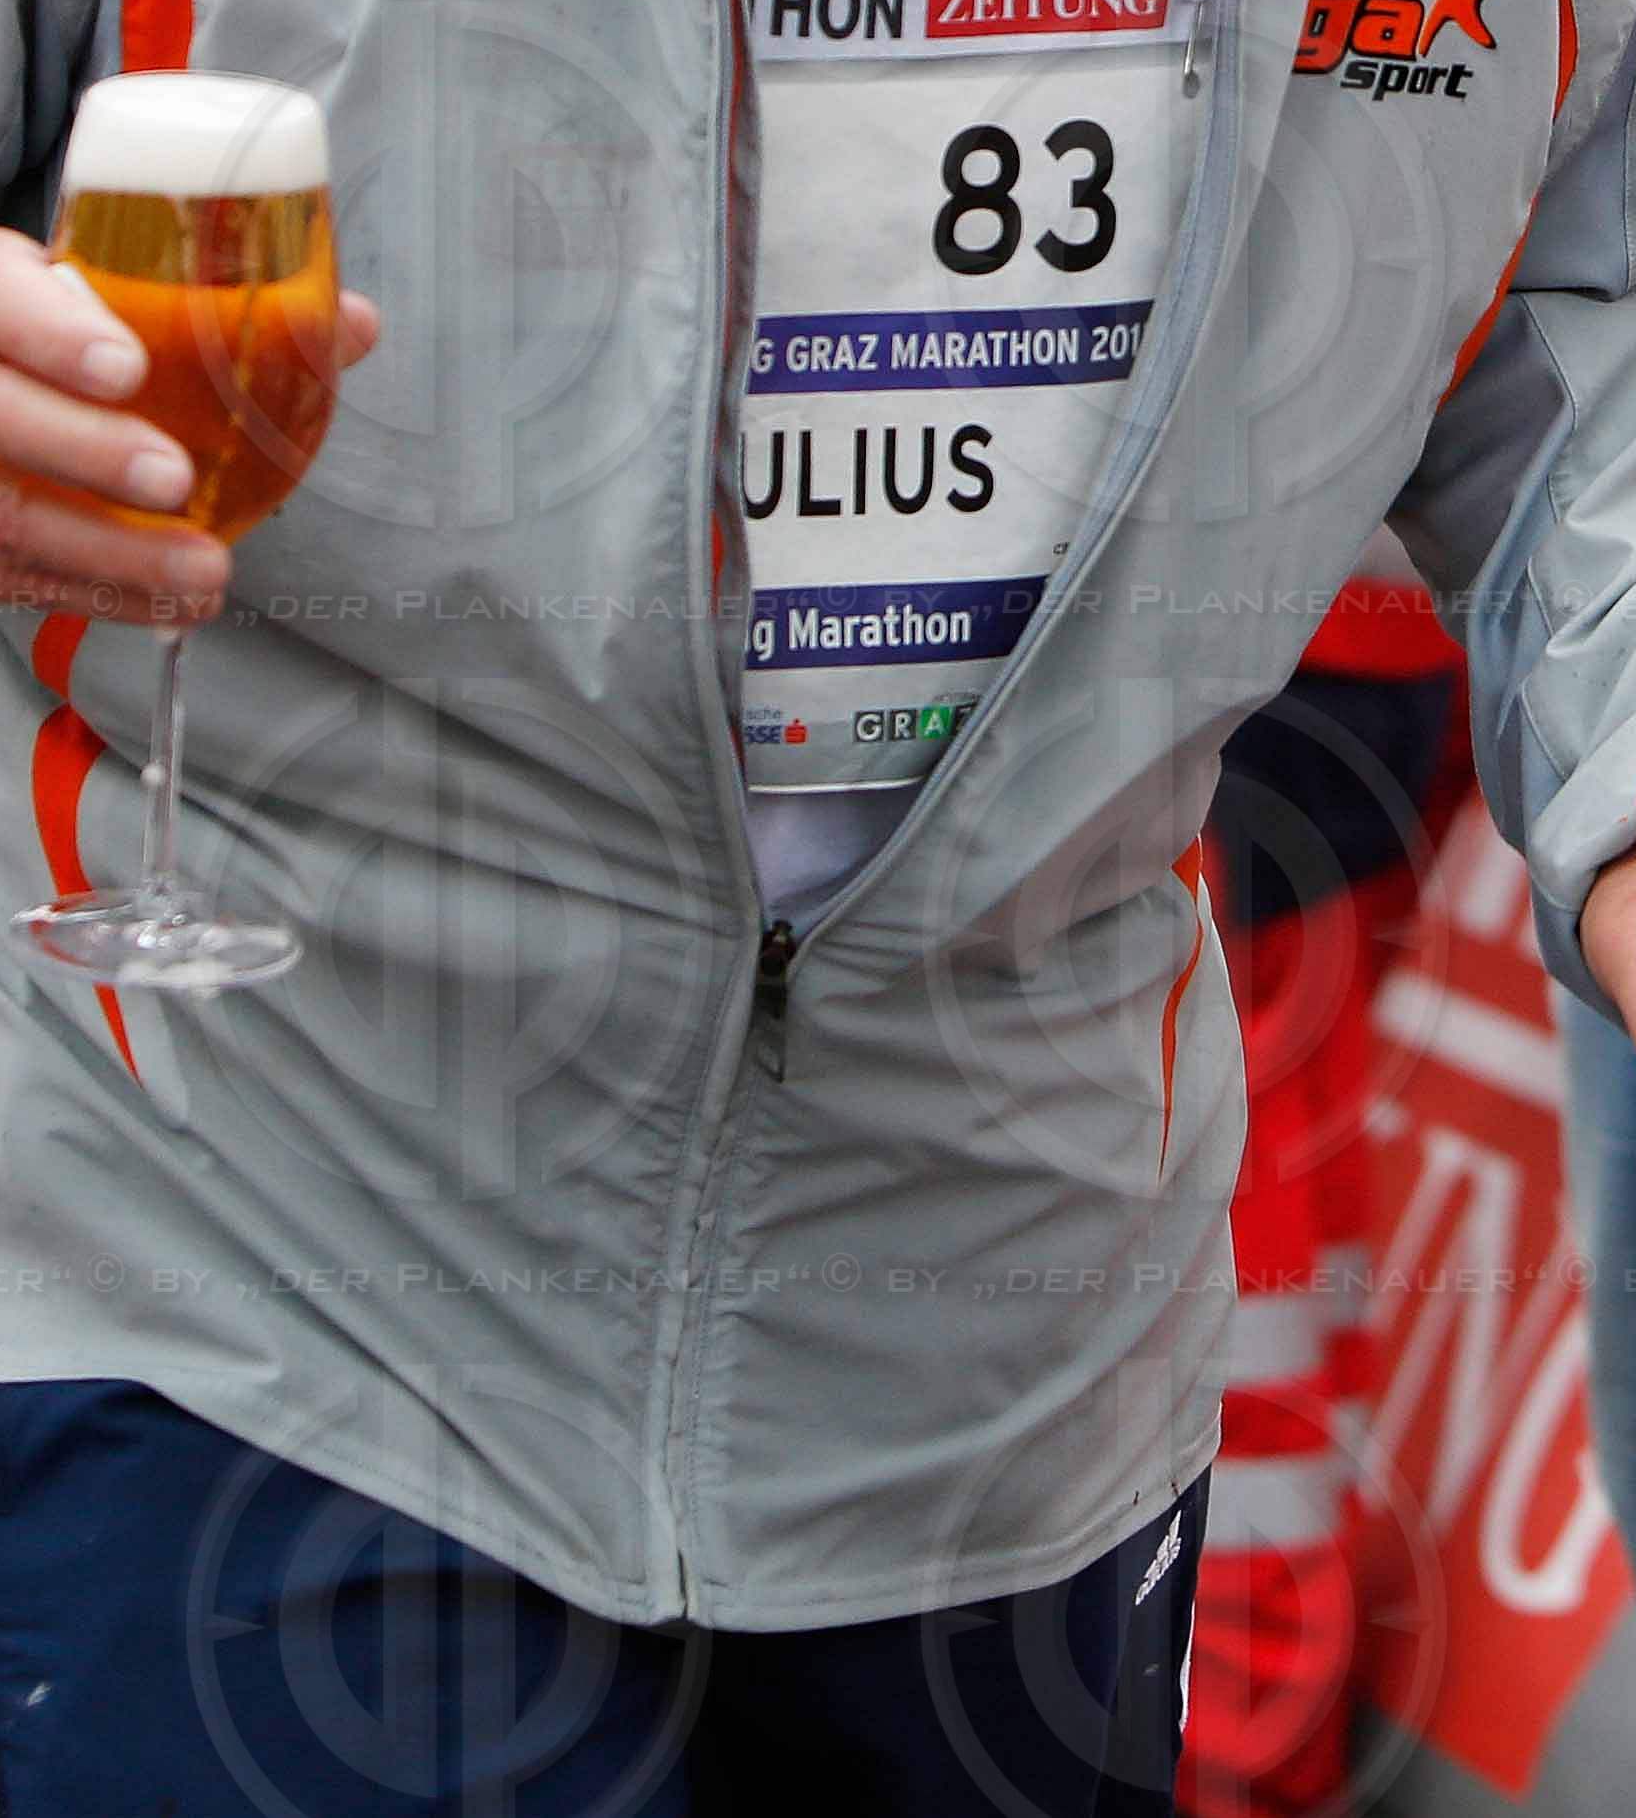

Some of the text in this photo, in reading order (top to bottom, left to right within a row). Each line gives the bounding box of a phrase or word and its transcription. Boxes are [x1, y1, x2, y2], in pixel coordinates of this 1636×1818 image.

[1340, 59, 1474, 102] sport
[933, 118, 1119, 276] 83
[785, 332, 880, 372] GRAZ
[889, 328, 1079, 370] MARATHON
[788, 604, 973, 651] Marathon
